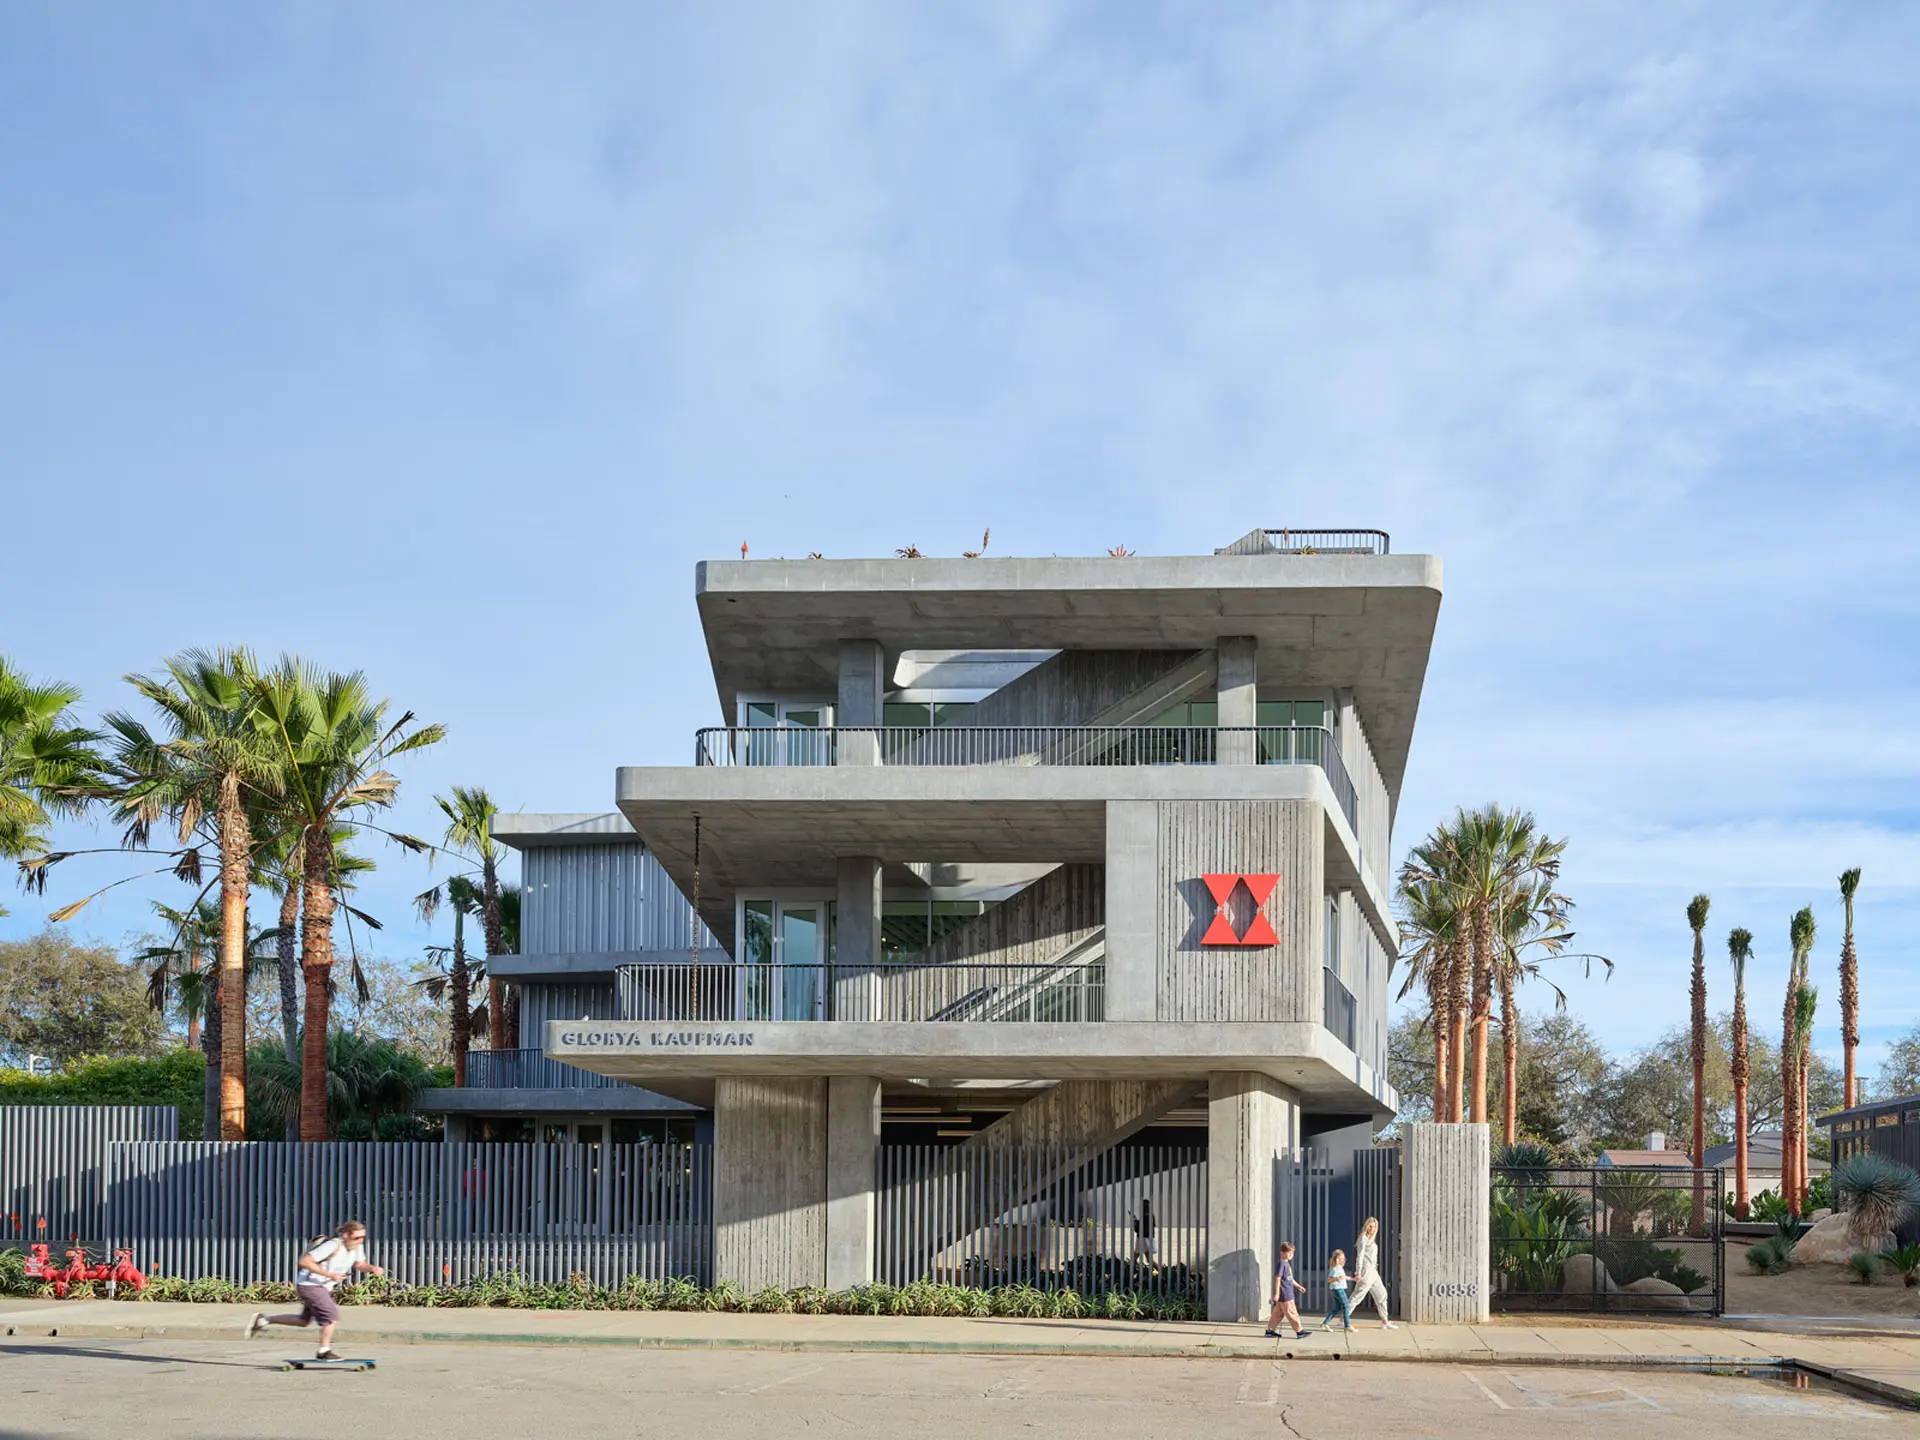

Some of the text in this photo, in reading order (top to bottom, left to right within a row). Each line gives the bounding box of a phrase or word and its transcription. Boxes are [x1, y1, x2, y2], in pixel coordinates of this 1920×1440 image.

[561, 1032, 754, 1046] GLORYA KAUFMAN
[1429, 1283, 1478, 1297] 10858
